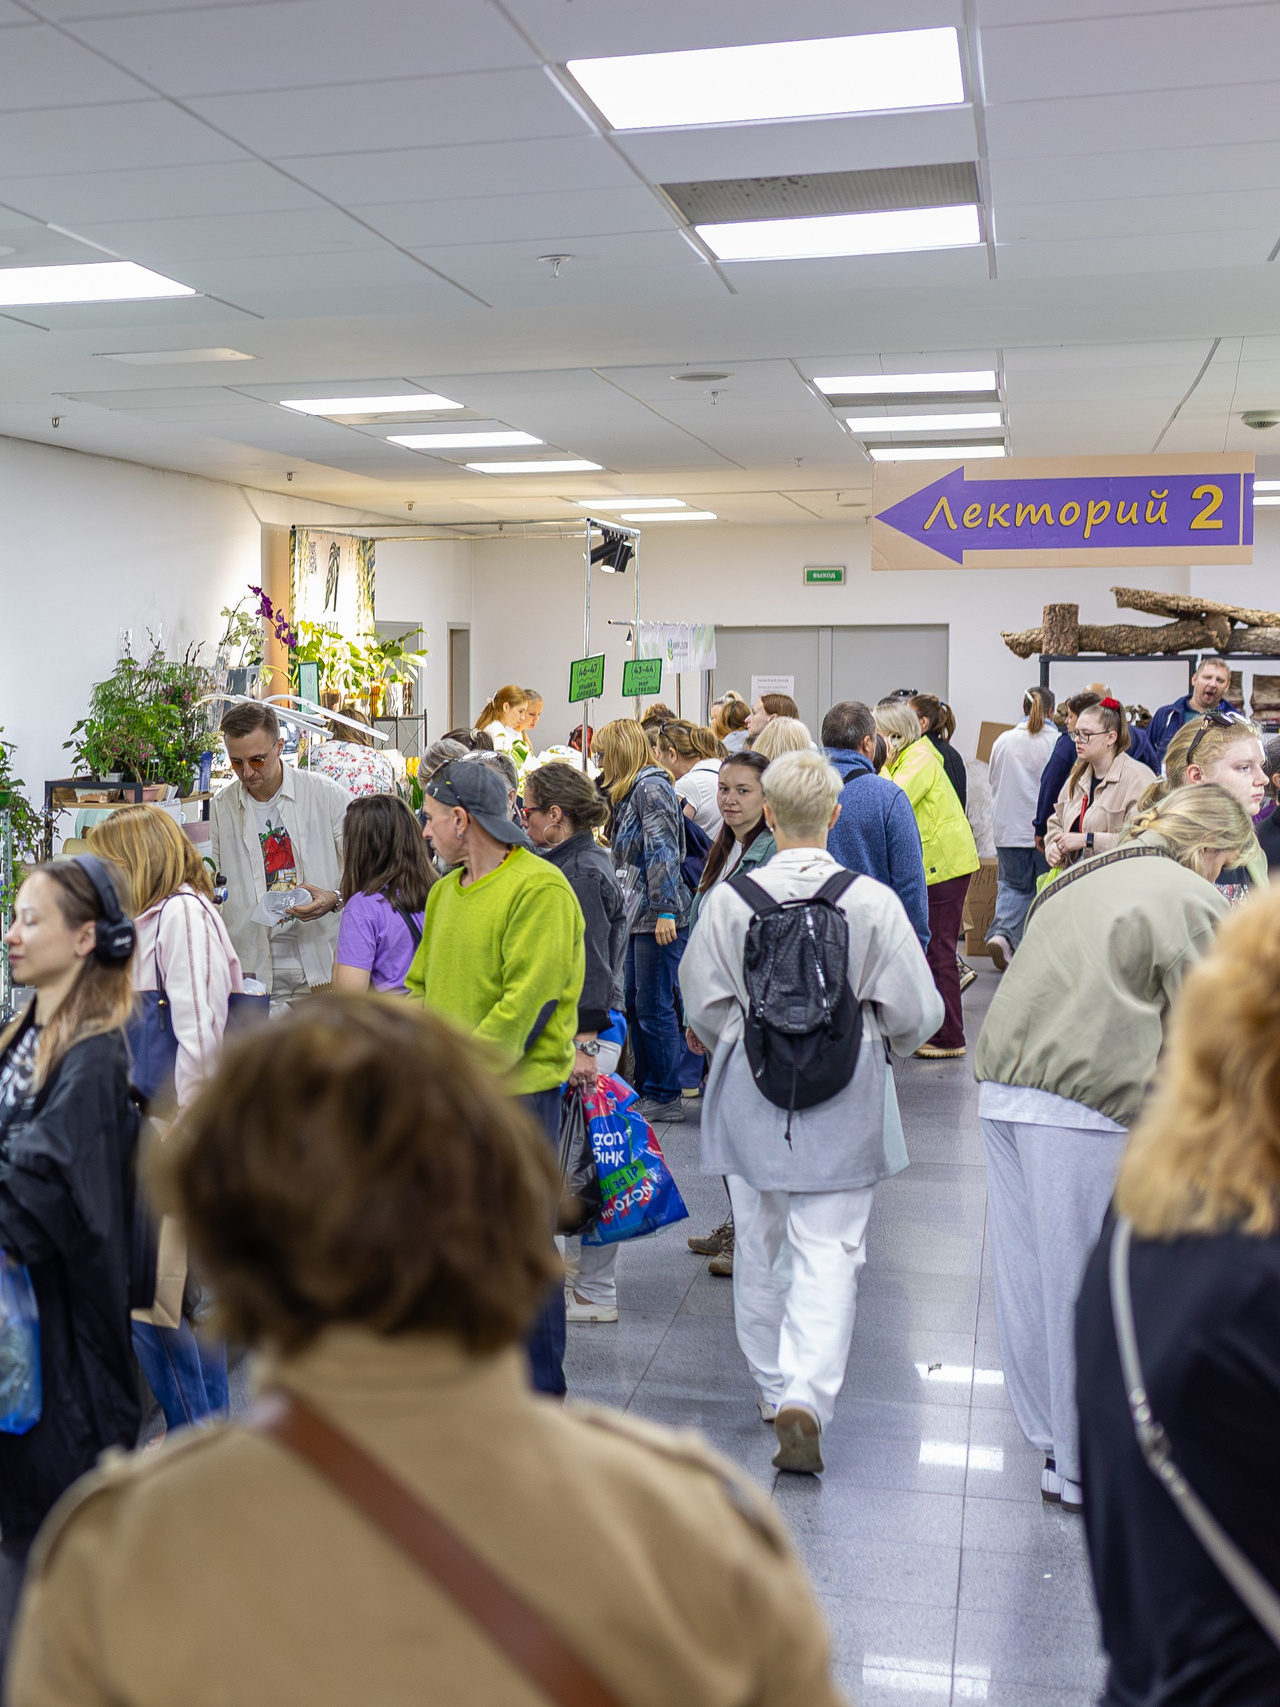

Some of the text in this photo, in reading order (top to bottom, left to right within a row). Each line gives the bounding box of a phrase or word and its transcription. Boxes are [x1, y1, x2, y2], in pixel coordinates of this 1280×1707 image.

[923, 484, 1224, 540] Лекторий 2
[812, 571, 836, 580] ВЫХОД
[579, 663, 597, 676] 46-47
[634, 665, 653, 673] 43-44
[614, 1181, 655, 1212] OZON
